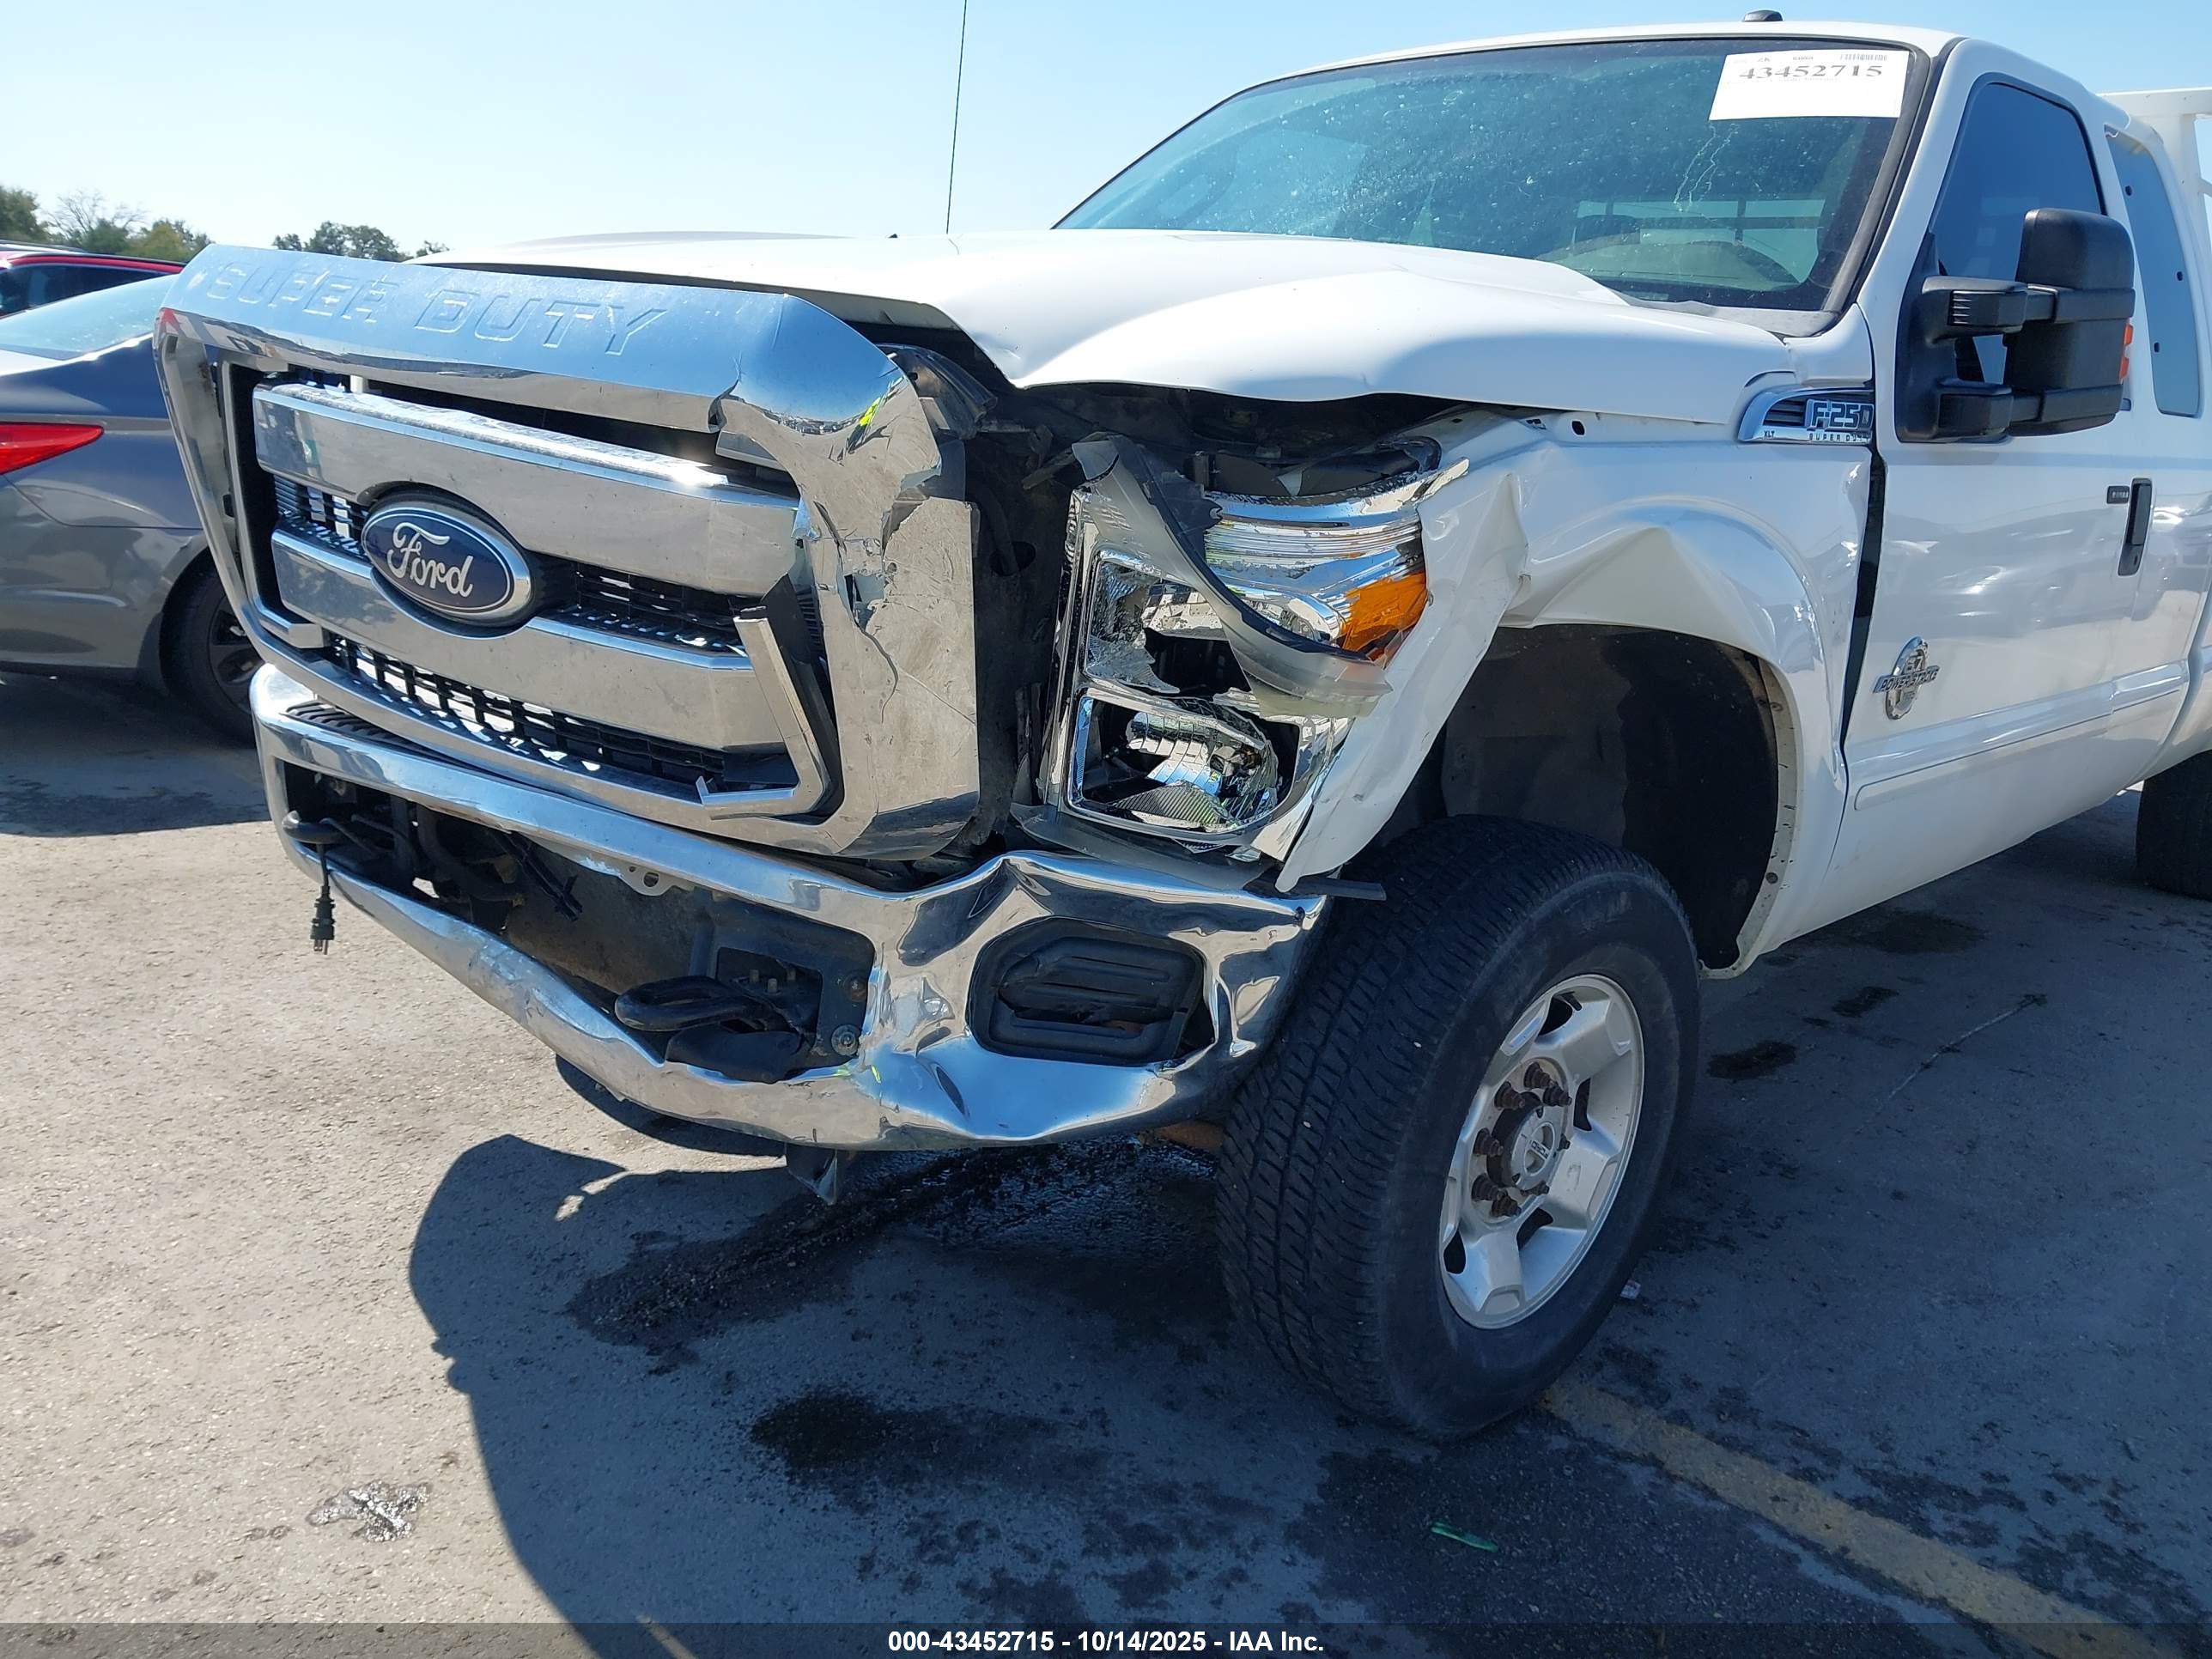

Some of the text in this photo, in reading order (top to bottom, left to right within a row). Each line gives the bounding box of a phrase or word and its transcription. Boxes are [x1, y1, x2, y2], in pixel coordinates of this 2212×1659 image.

[1739, 64, 1883, 79] 43452715
[205, 260, 668, 356] SUPER DUTY
[1764, 429, 1776, 438] XLT
[1808, 432, 1841, 441] SUPER
[387, 521, 474, 598] Ford
